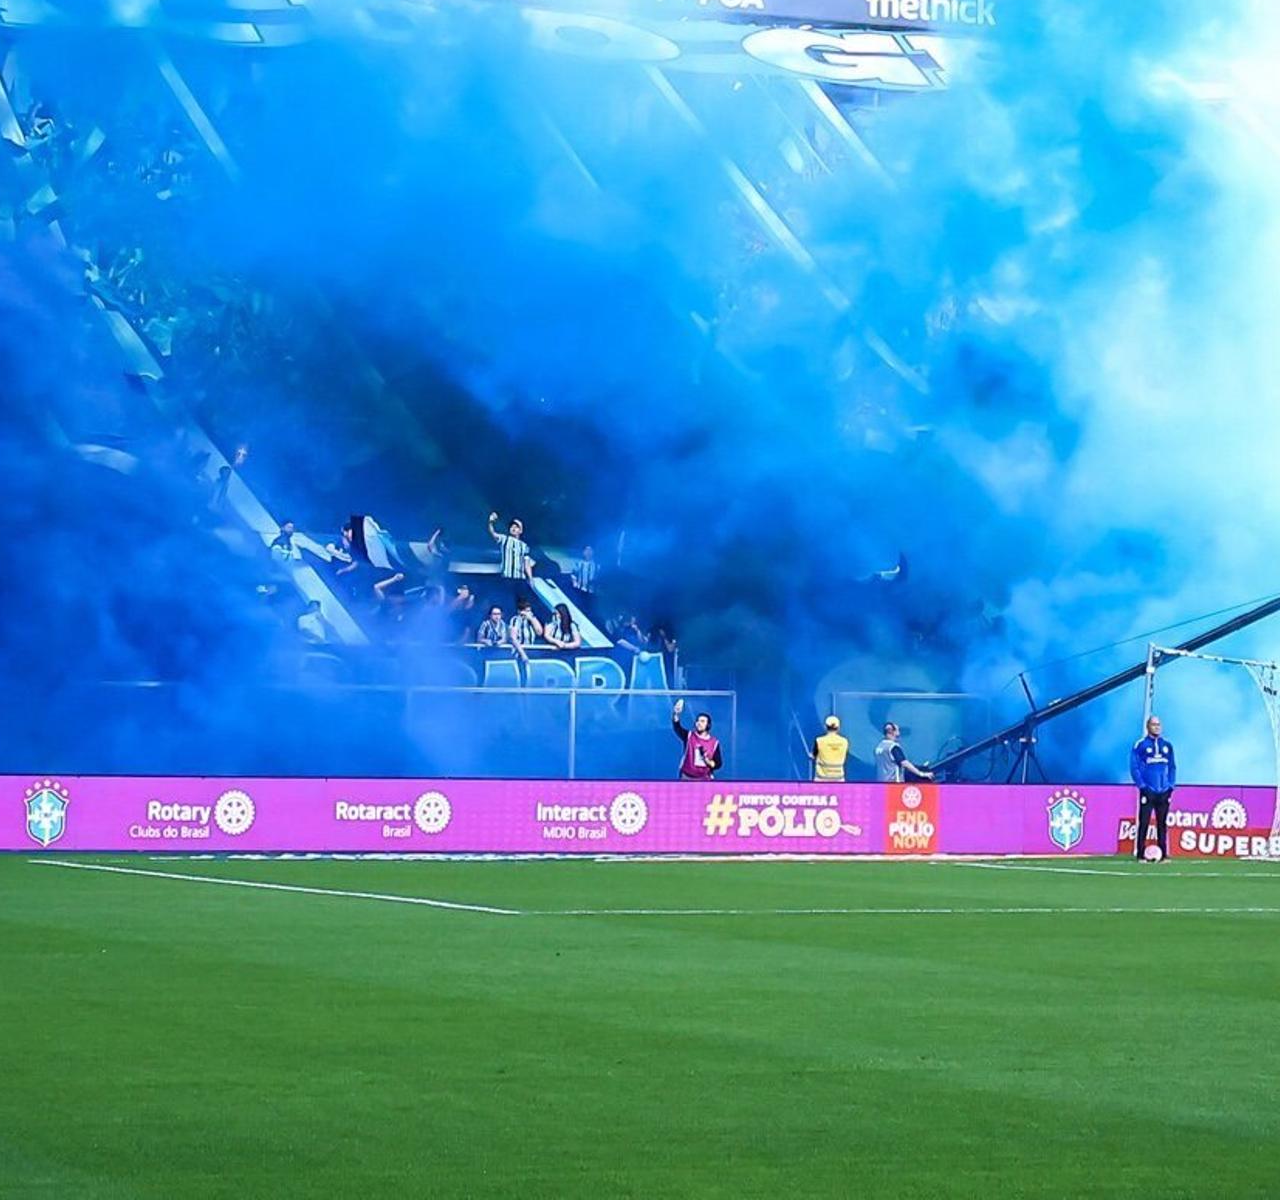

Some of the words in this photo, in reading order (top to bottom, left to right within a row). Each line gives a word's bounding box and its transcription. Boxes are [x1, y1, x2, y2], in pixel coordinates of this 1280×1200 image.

[738, 795, 780, 807] JUNTOS
[782, 795, 827, 807] CONTRA
[829, 795, 839, 806] A
[147, 800, 211, 824] Rotary
[335, 801, 411, 821] Rotaract
[536, 802, 607, 822] Interact
[896, 811, 927, 824] END
[1166, 810, 1209, 828] otary
[130, 825, 160, 838] Clubs
[163, 825, 178, 838] do
[181, 825, 210, 838] Brasil
[382, 825, 411, 838] Brasil
[543, 826, 574, 839] MDIO
[576, 826, 607, 839] Brasil
[889, 822, 933, 838] POLIO
[894, 835, 929, 849] NOW
